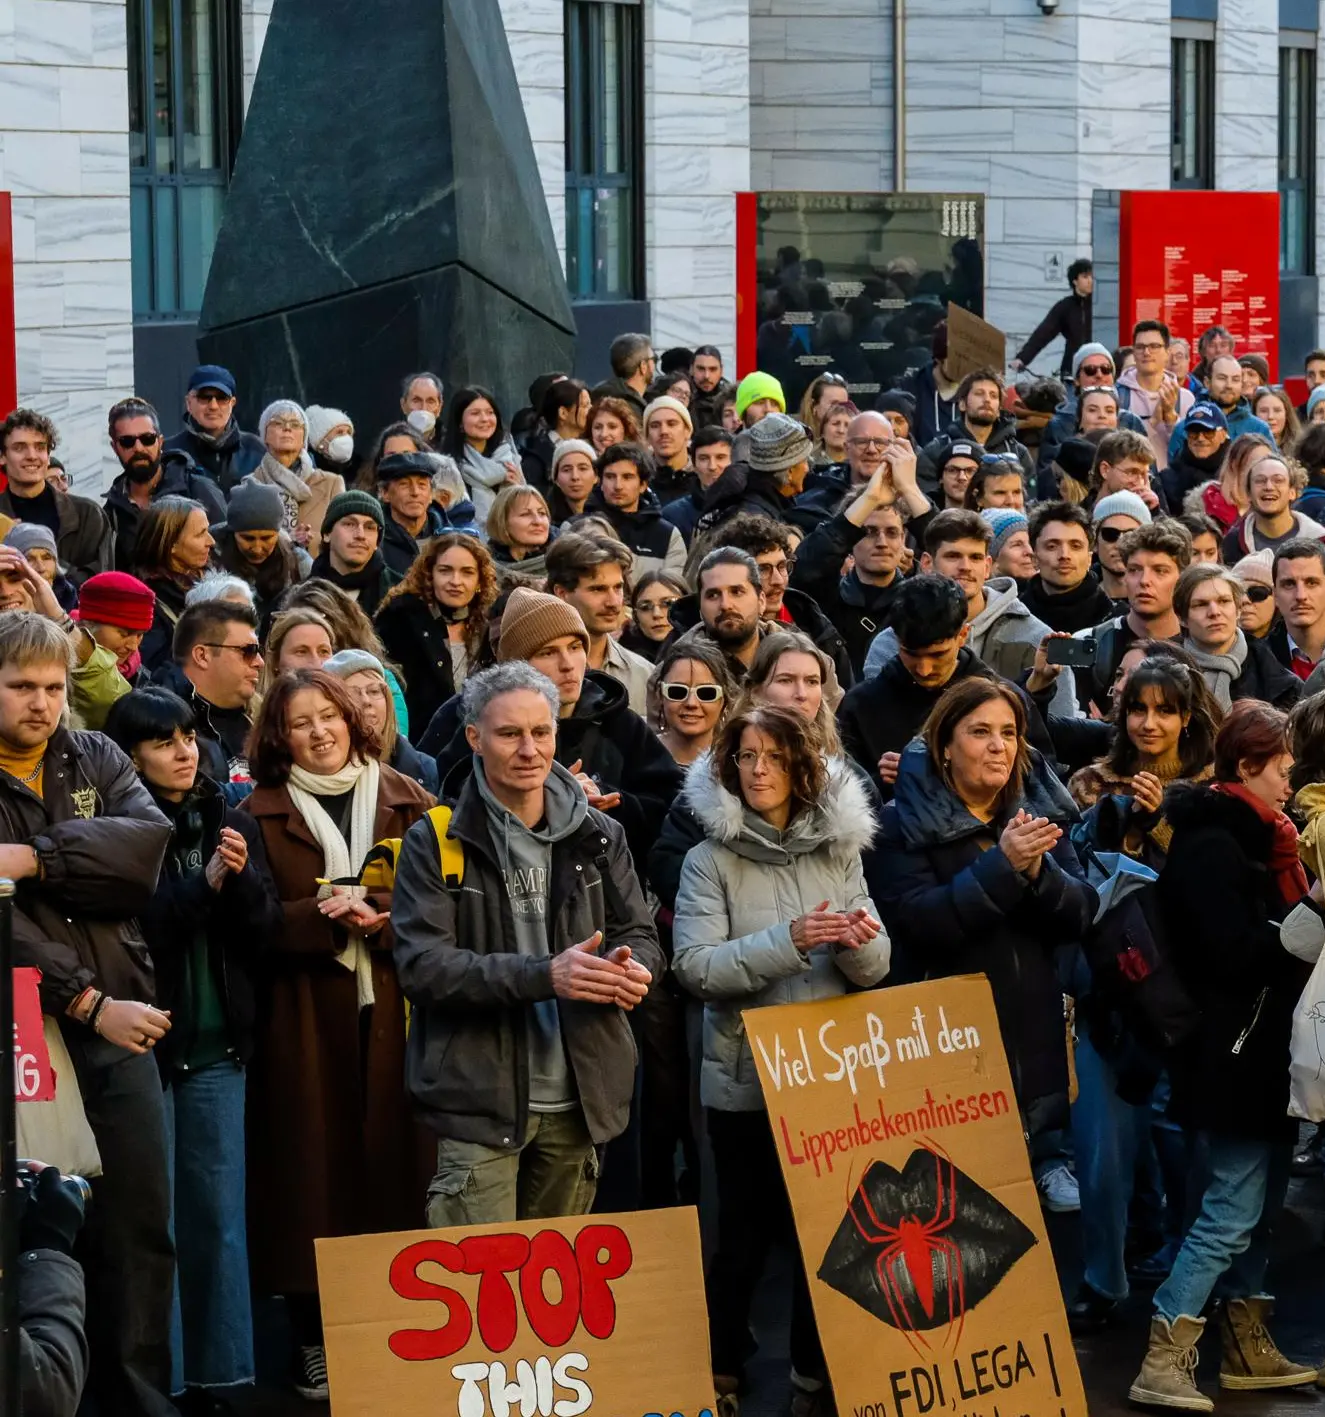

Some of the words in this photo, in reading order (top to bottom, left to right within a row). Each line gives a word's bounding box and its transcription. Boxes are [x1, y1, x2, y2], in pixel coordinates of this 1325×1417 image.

[756, 1028, 816, 1092] Viel
[818, 1012, 891, 1095] Spaß
[896, 1005, 931, 1062] mit
[937, 1005, 981, 1054] den
[779, 1088, 1009, 1178] Lippenbekenntnissen
[388, 1224, 633, 1361] STOP
[451, 1352, 593, 1417] THIS
[954, 1340, 1036, 1400] LEGA
